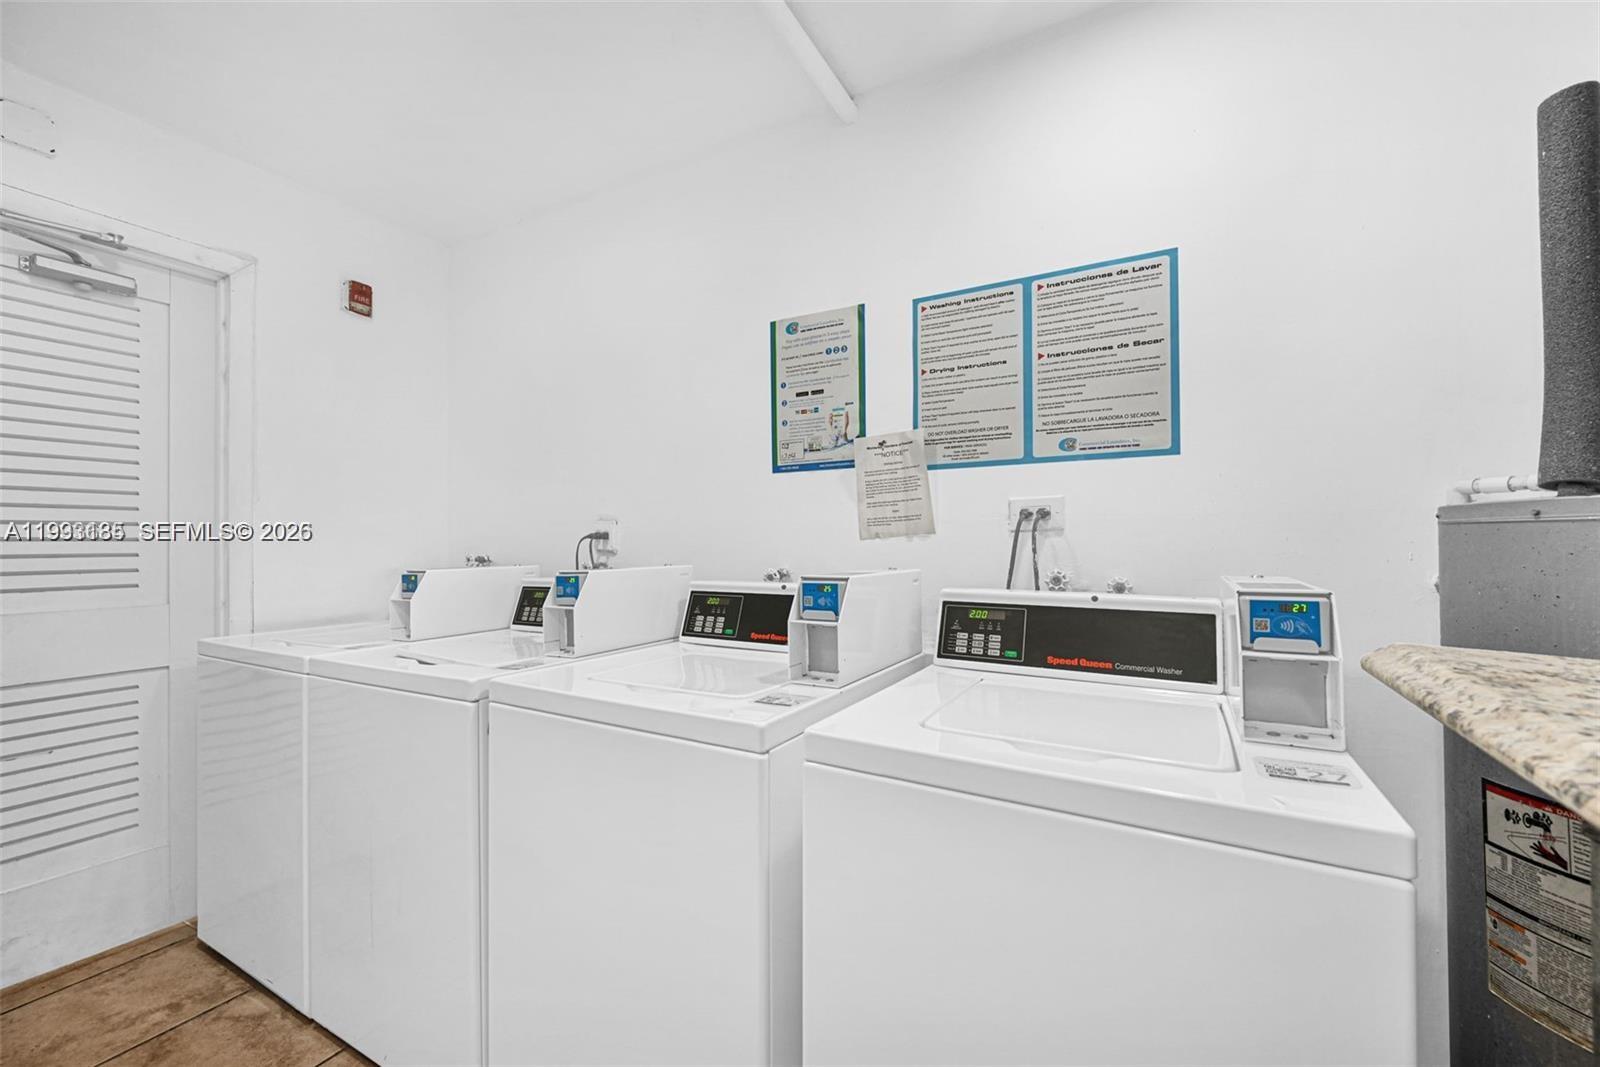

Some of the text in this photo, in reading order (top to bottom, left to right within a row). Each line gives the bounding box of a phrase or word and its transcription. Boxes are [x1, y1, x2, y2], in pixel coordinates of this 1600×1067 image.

[1046, 263, 1163, 288] Instrucciones de Lavar
[929, 290, 1014, 310] Washing Instructions
[1047, 337, 1165, 359] Instrucciones de Secar
[929, 359, 1007, 375] Drying Instructions
[1095, 414, 1124, 422] LAVADORA
[1292, 603, 1307, 613] 27
[1047, 656, 1184, 676] Speed Queen Commercial Washer
